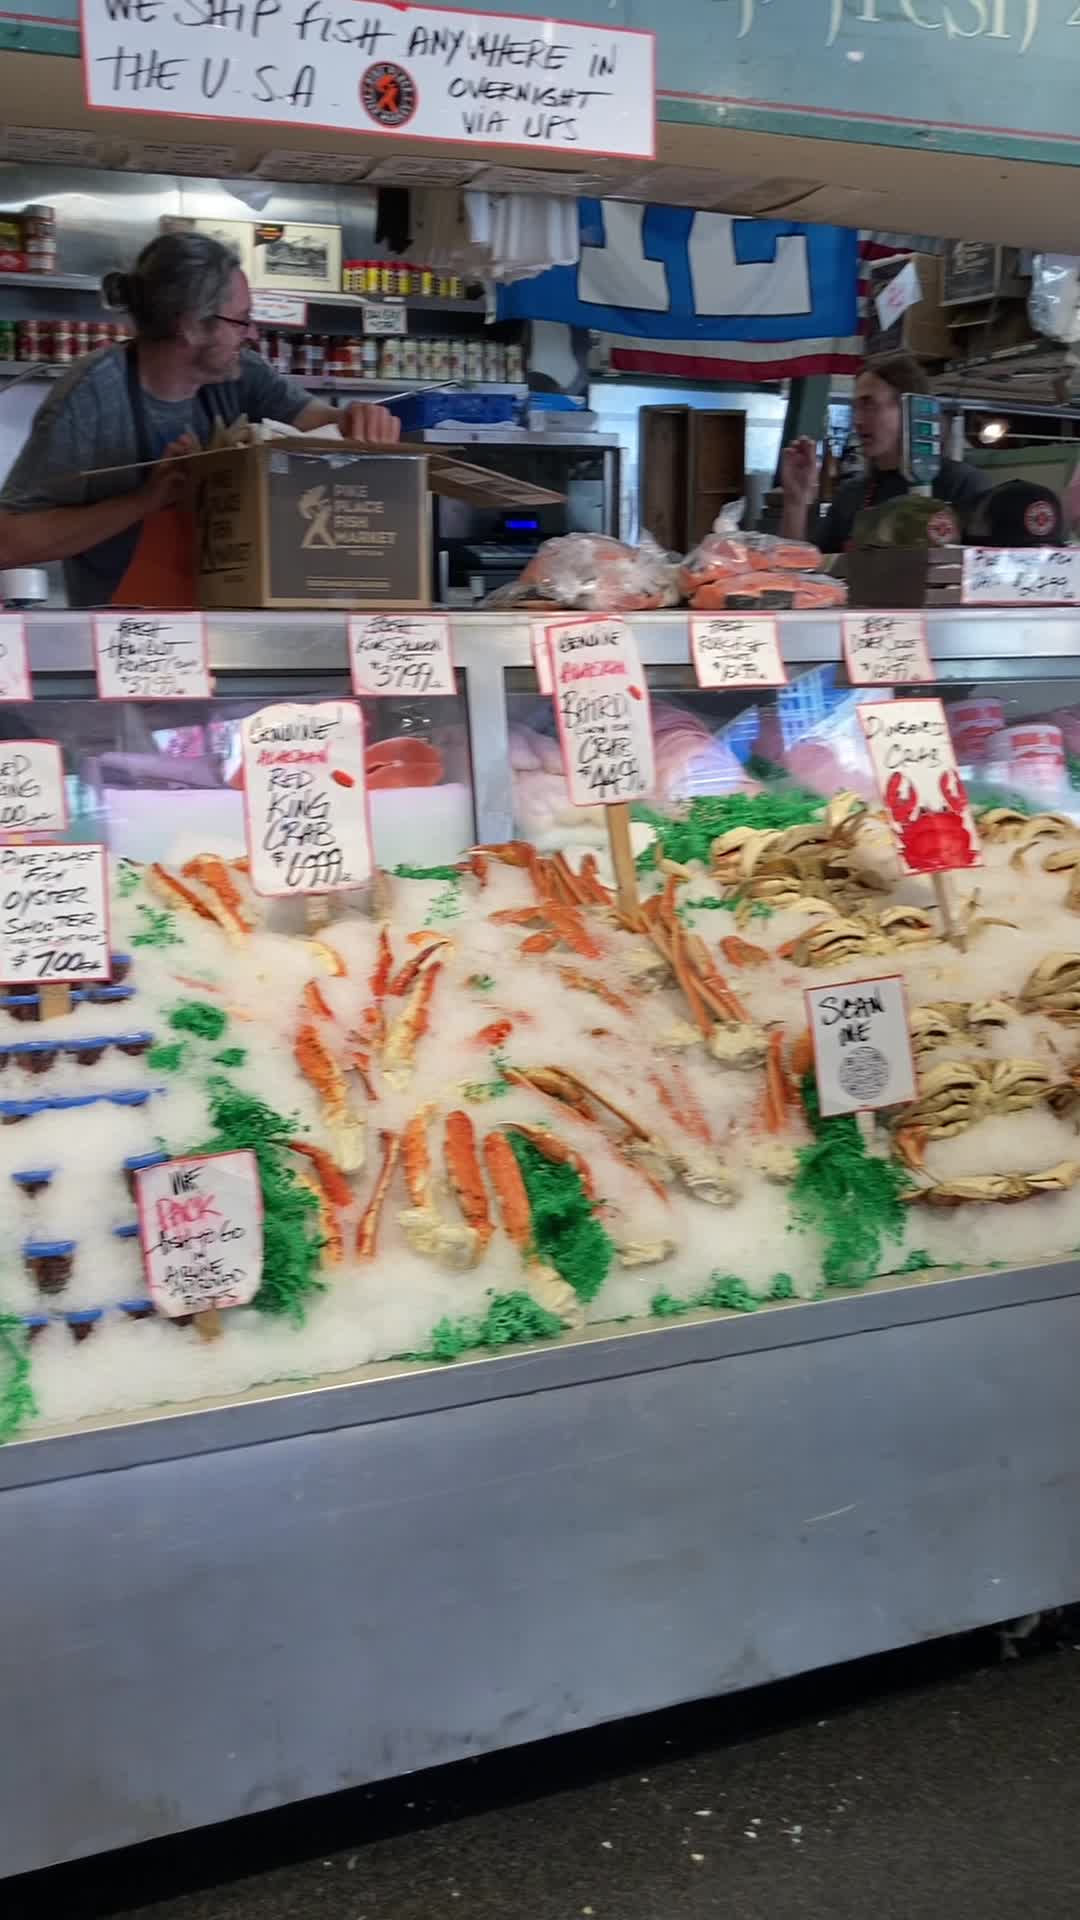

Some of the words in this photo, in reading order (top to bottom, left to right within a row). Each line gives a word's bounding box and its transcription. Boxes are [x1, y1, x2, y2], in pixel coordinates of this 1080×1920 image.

[294, 0, 394, 55] FISH
[407, 26, 573, 69] ANYWHERE
[96, 46, 188, 91] THE
[448, 77, 613, 108] OVERNIGHT
[461, 105, 509, 134] VIA
[523, 115, 578, 141] UPS
[267, 768, 314, 792] RED
[267, 790, 330, 822] KING
[3, 887, 89, 916] OYSTER
